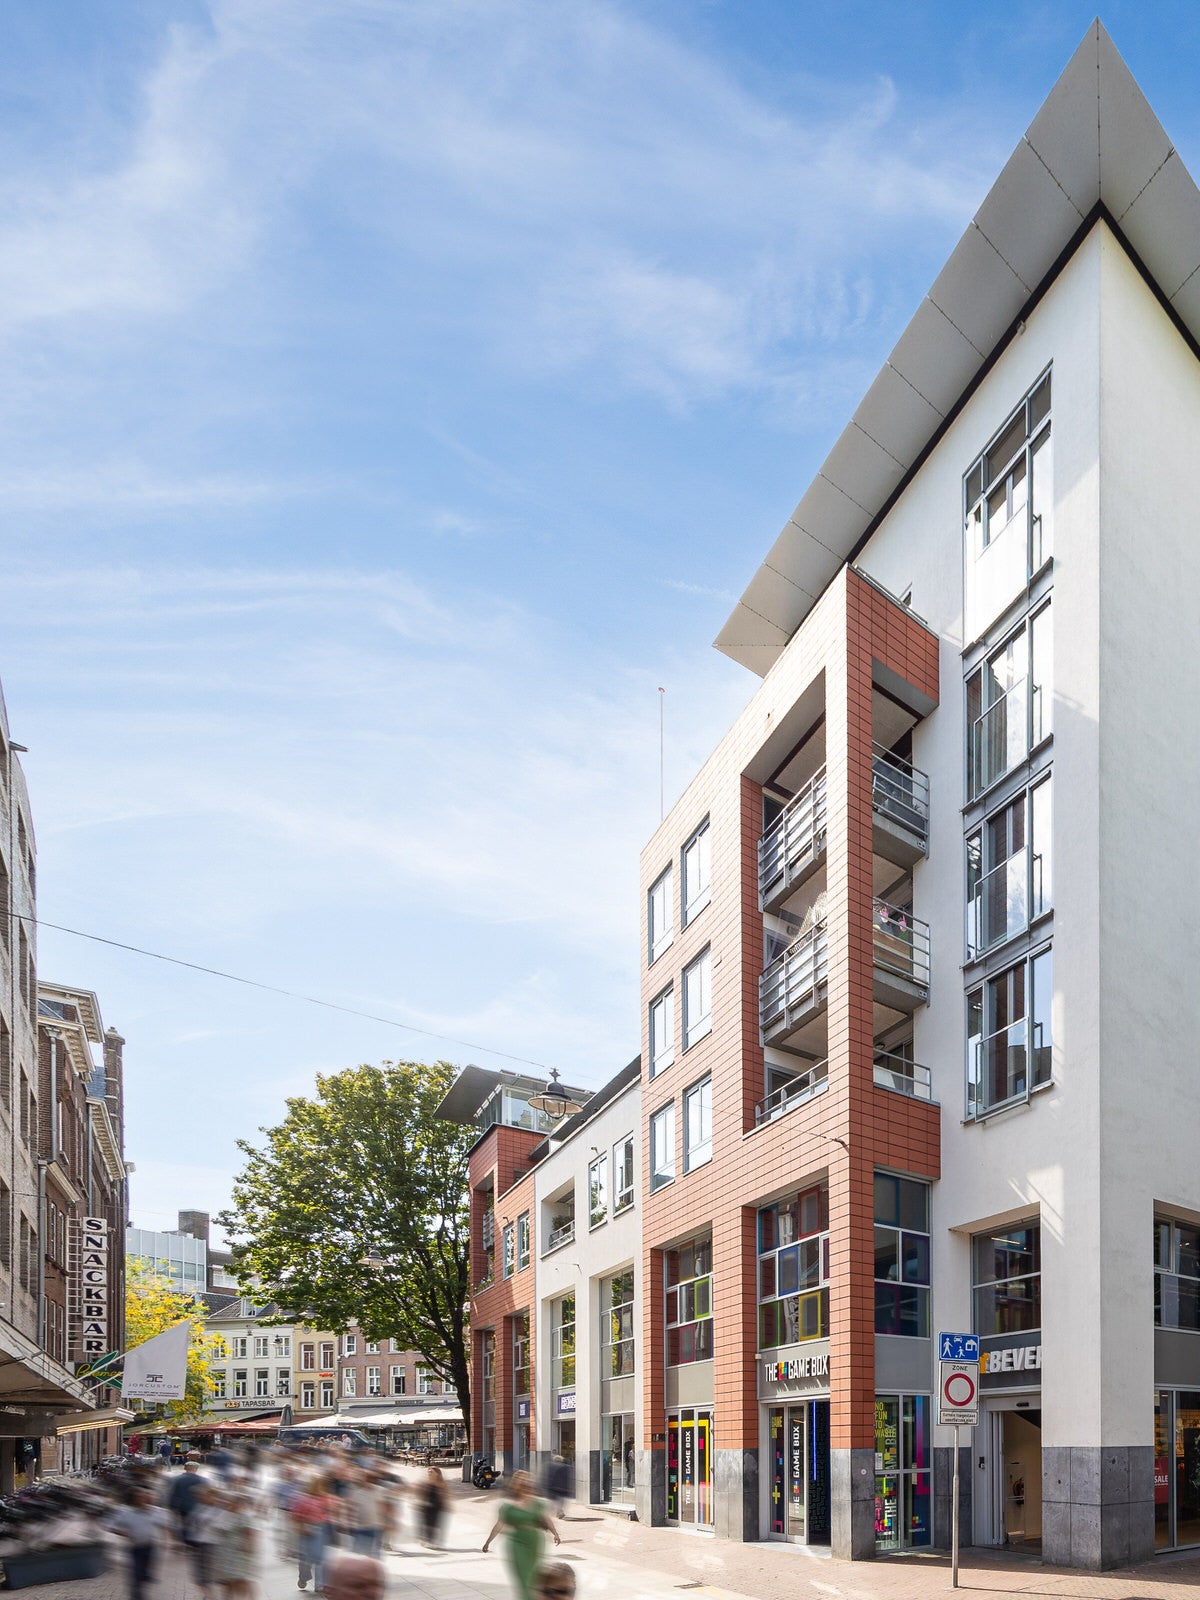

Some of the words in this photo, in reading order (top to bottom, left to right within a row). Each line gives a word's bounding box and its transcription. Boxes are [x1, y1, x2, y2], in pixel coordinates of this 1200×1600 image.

[84, 1218, 104, 1352] SNACKBAR
[764, 1362, 778, 1382] THE
[788, 1358, 810, 1379] GAME
[811, 1355, 829, 1377] BOX
[875, 1411, 888, 1420] FUN
[875, 1429, 897, 1438] WASTE
[1154, 1474, 1169, 1484] SALE
[885, 1498, 896, 1519] THE
